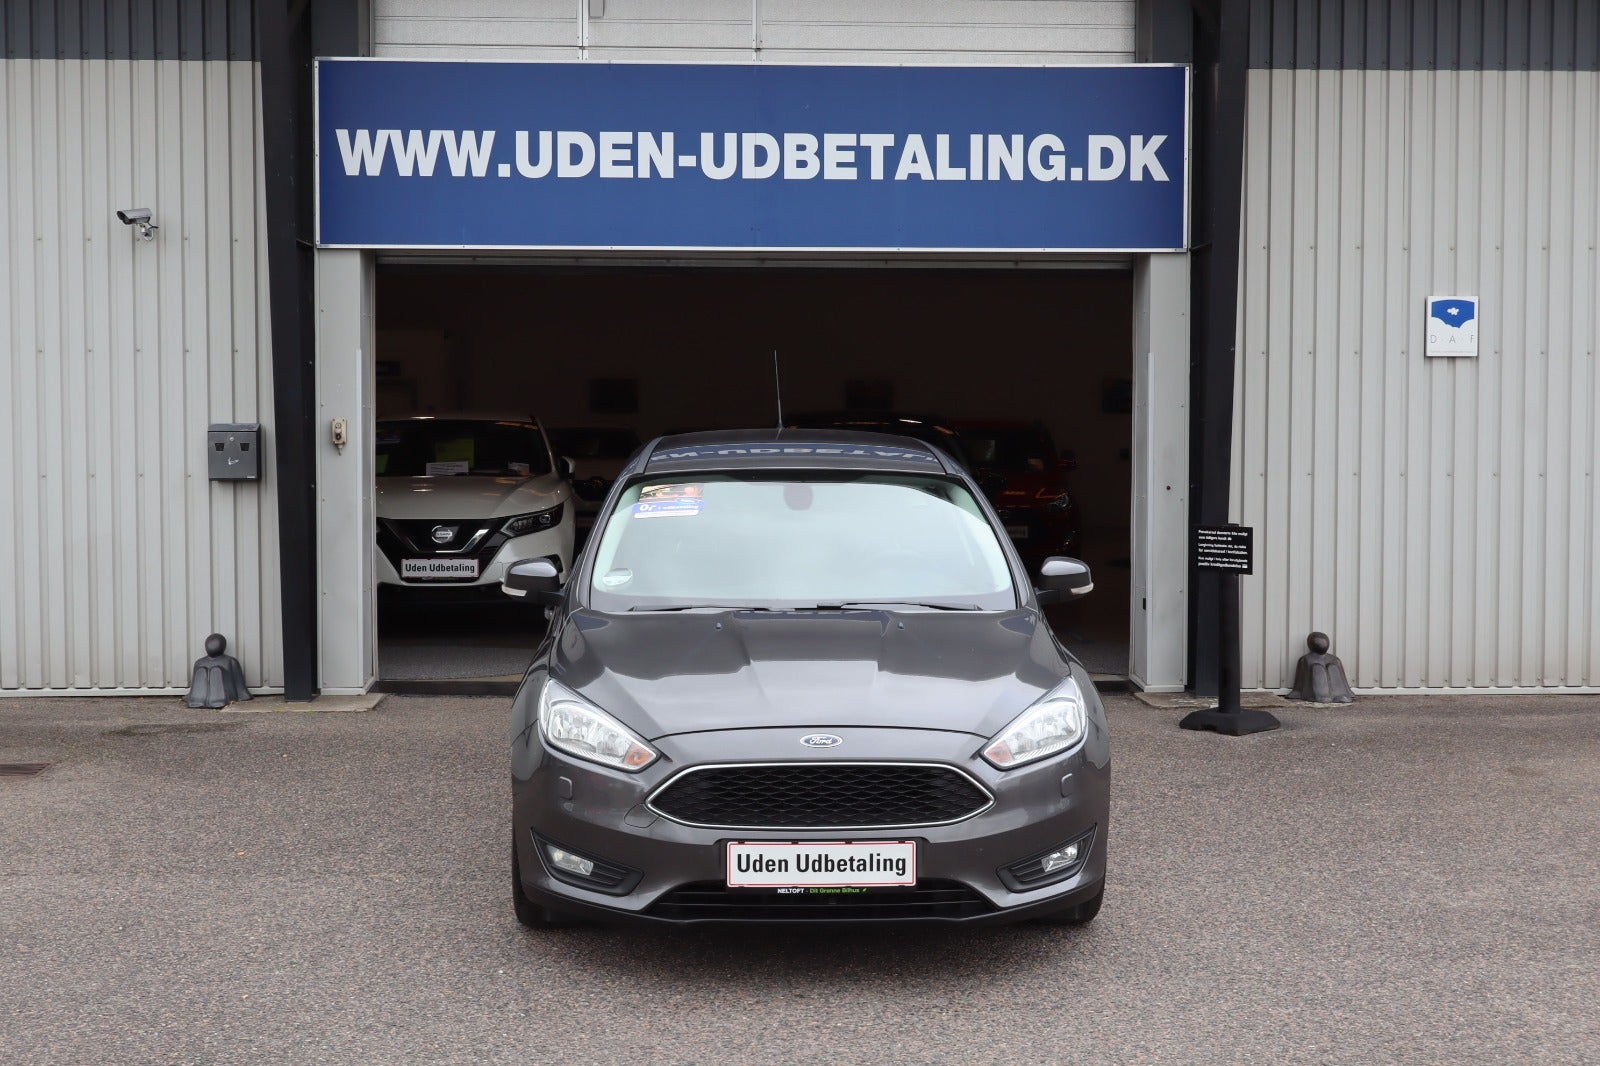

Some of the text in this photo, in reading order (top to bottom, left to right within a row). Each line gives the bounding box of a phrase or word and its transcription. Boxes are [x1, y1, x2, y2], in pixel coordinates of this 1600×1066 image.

[335, 128, 1170, 183] WWW.UDEN-UDBETALING.DK
[405, 563, 475, 573] Uden Udbetaling
[810, 736, 832, 745] Ford
[737, 853, 906, 876] Uden Udbetaling
